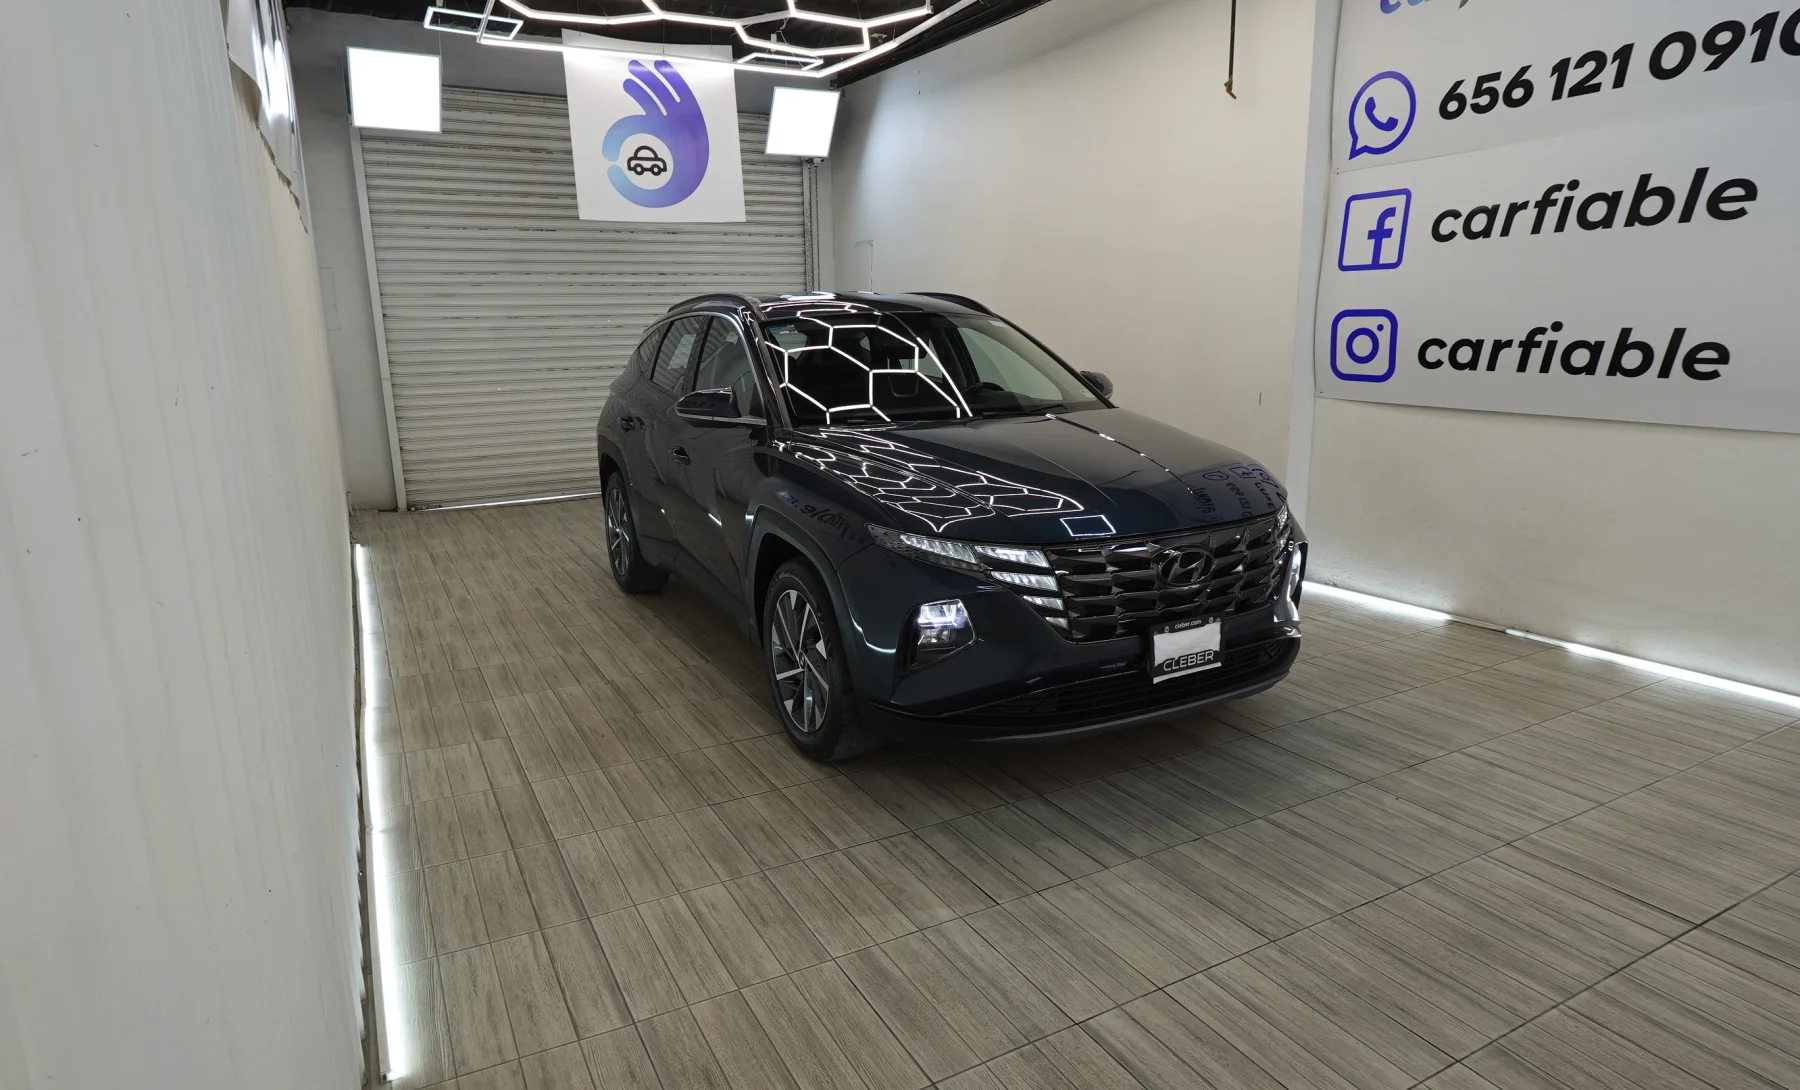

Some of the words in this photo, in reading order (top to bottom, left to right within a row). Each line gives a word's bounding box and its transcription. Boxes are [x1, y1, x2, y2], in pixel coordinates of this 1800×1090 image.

[1438, 64, 1535, 121] 656
[1549, 42, 1635, 102] 121
[1430, 166, 1759, 244] carfiable
[1416, 320, 1732, 381] carfiable
[1175, 620, 1202, 629] cleber.com
[1164, 651, 1214, 671] CLEBER
